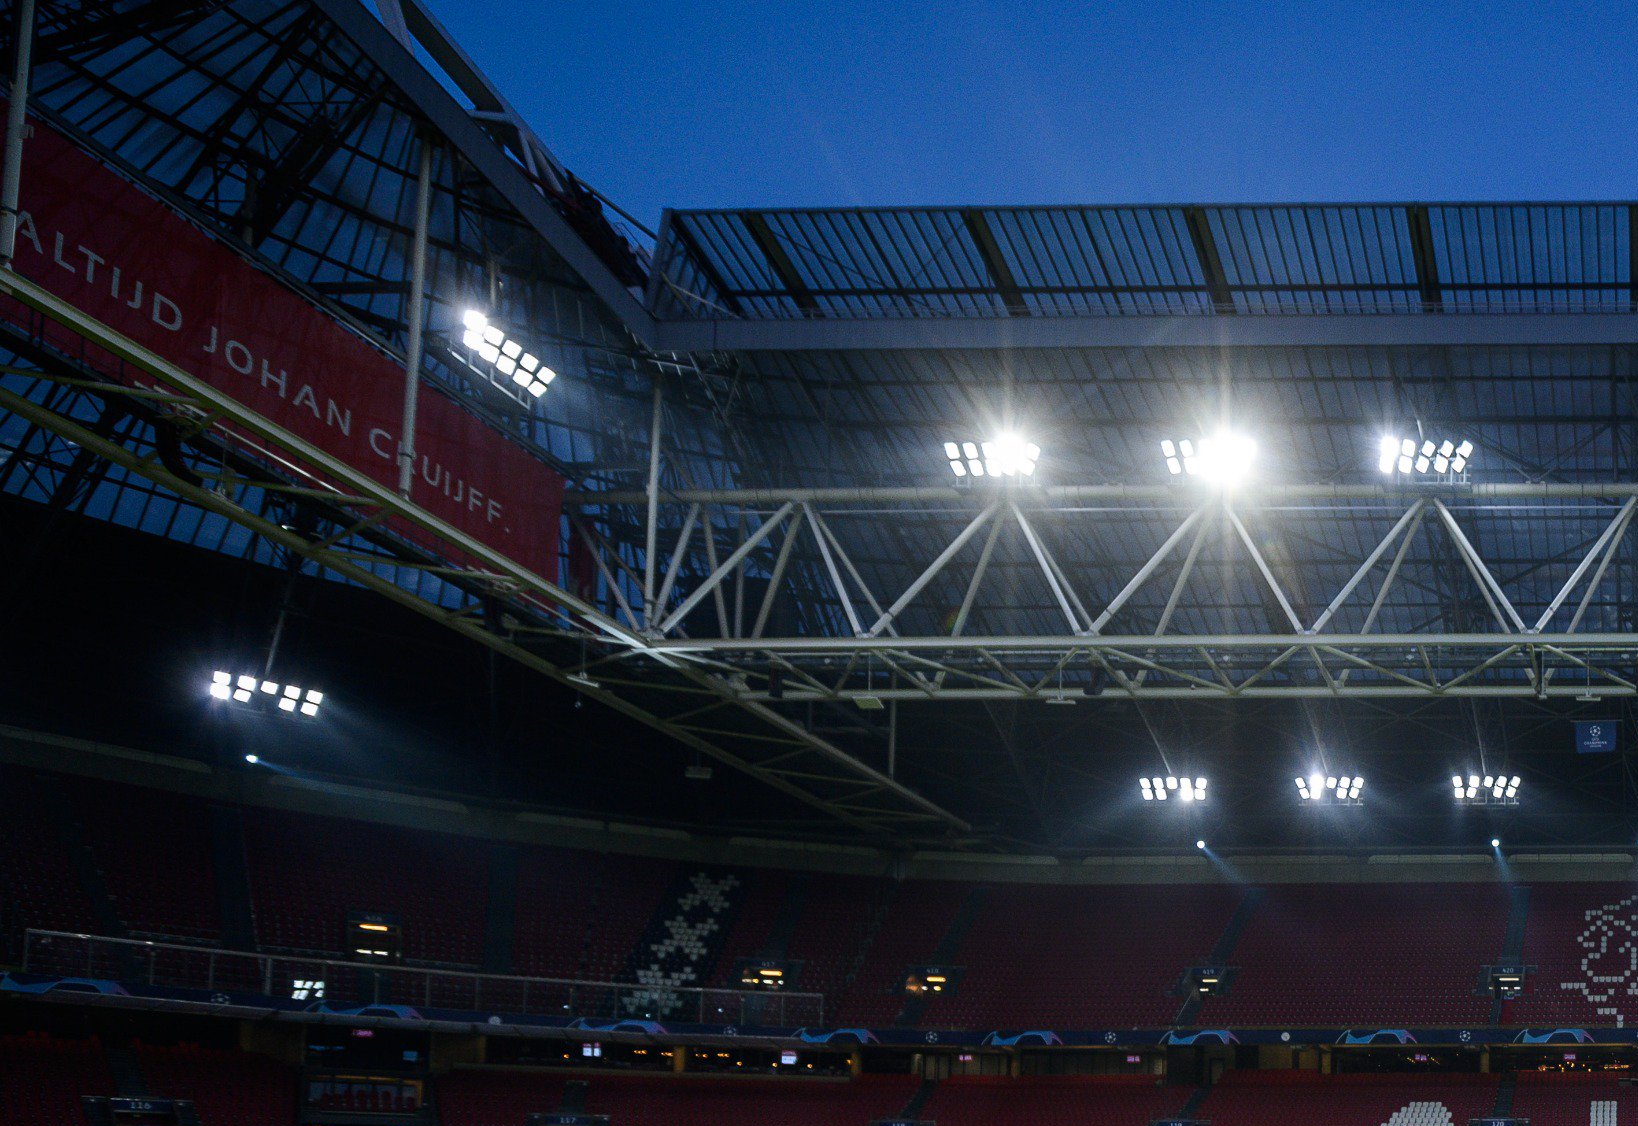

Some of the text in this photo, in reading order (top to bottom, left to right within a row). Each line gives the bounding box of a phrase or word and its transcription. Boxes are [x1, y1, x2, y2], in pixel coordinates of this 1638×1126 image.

[15, 209, 184, 332] ALTIJD
[202, 325, 352, 438] JOHAN
[130, 1101, 152, 1109] 116
